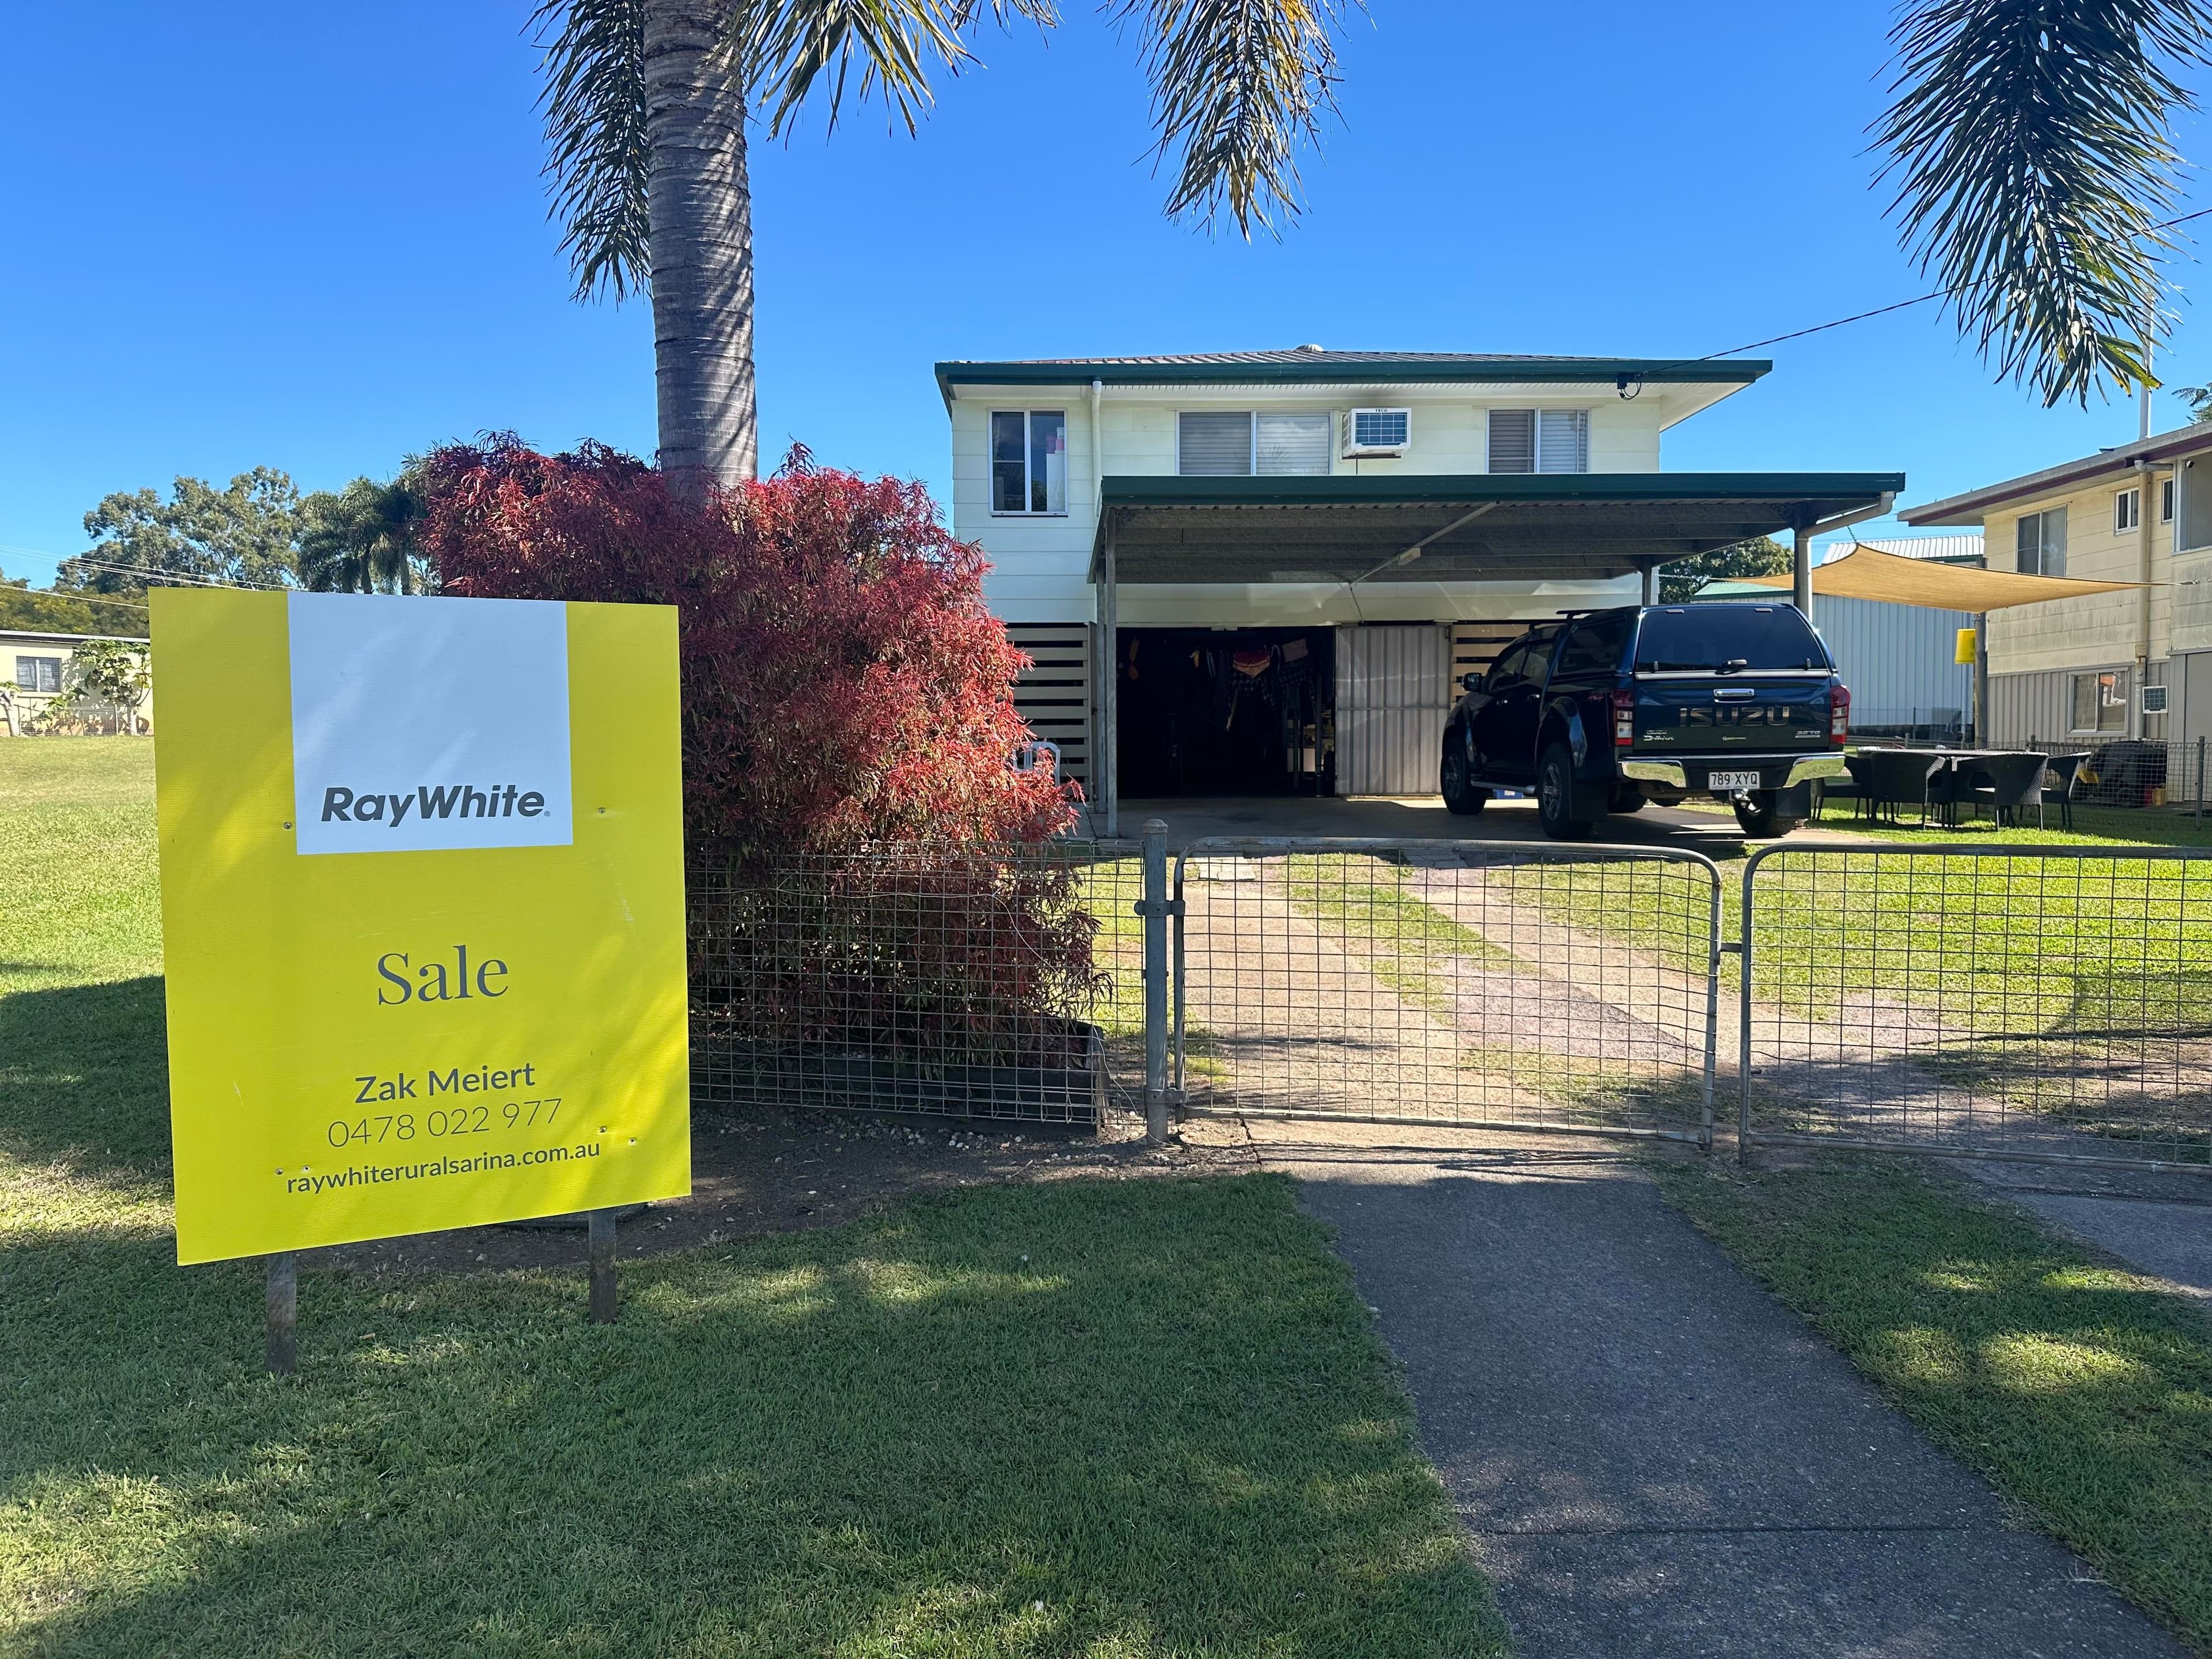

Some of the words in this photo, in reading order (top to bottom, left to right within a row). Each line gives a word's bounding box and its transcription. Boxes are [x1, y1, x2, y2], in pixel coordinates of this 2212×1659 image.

[1679, 706, 1790, 728] ISUZU
[1711, 774, 1730, 786] 789
[1734, 772, 1758, 785] XYQ
[377, 944, 509, 1006] Sale
[355, 1073, 417, 1104] Zak
[429, 1063, 536, 1096] Meiert
[328, 1114, 415, 1147] 0478
[427, 1106, 490, 1137] 022
[502, 1098, 562, 1129] 977
[287, 1143, 600, 1194] raywhiteruralsarina.com.au
